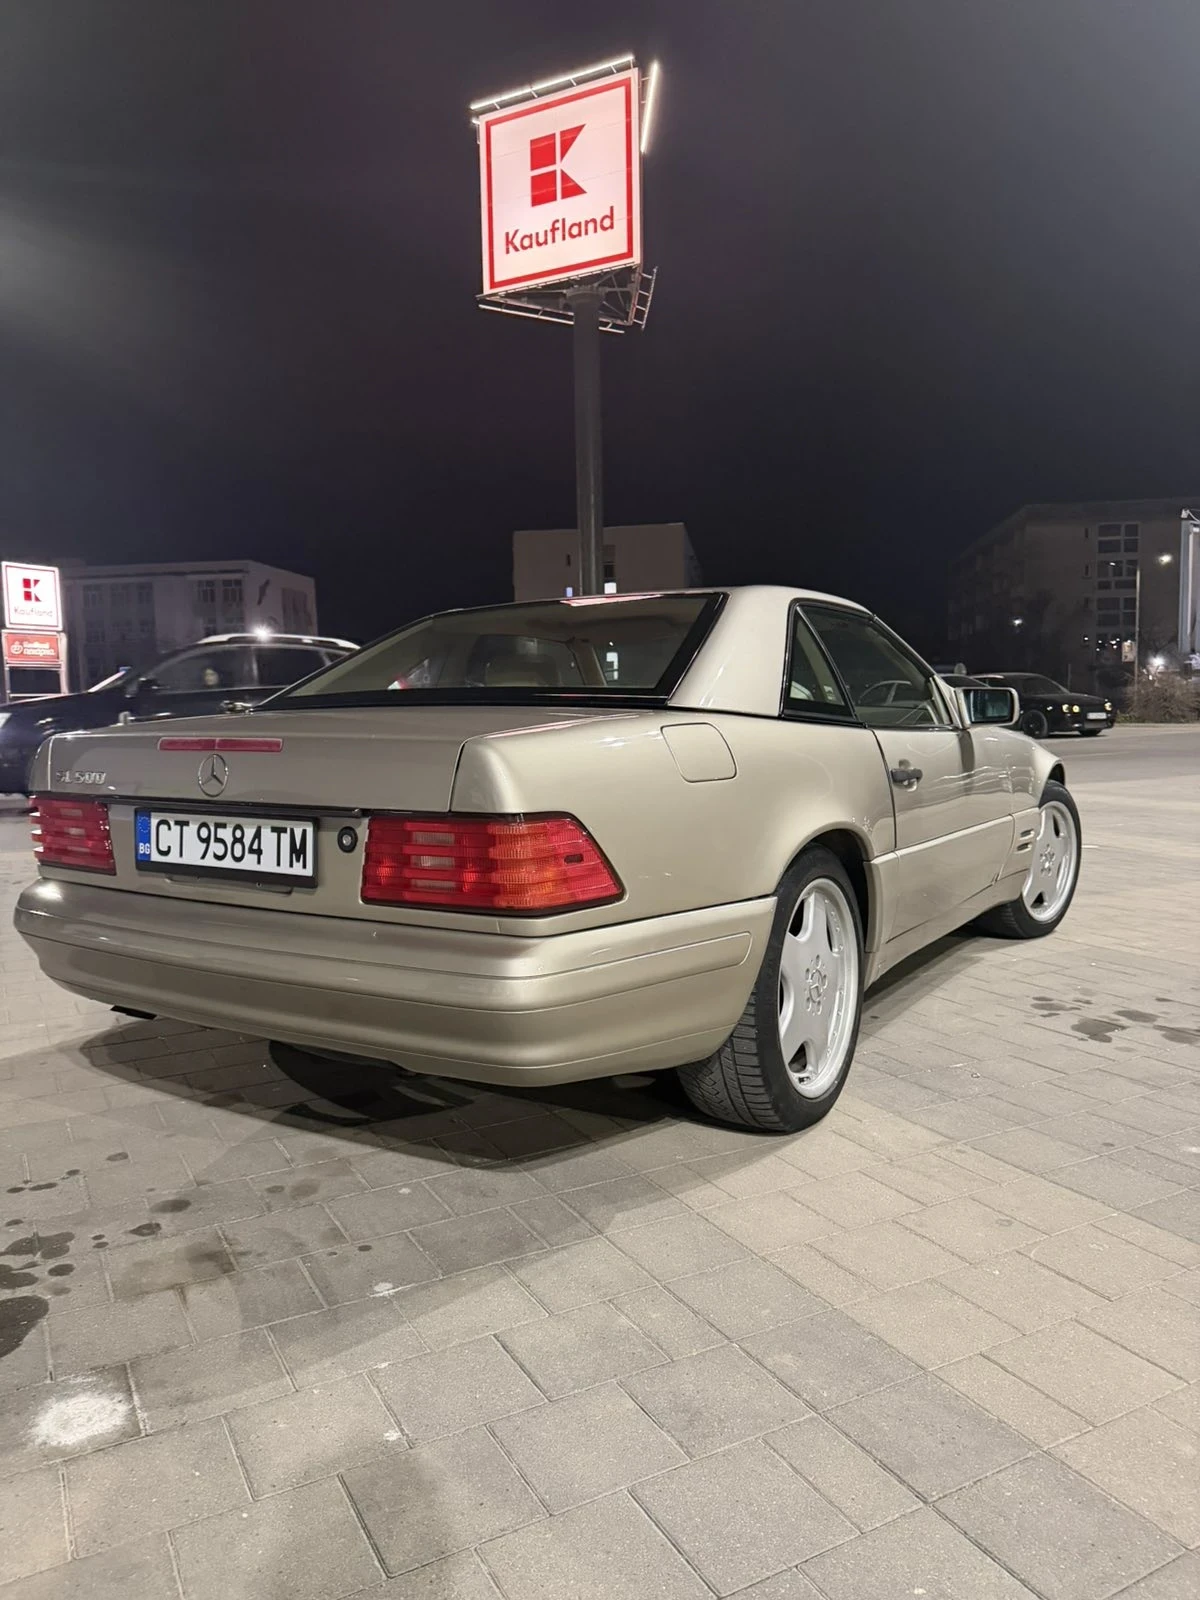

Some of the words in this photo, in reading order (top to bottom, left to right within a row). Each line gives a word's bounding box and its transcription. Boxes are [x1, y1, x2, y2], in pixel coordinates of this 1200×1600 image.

[504, 205, 616, 255] Kaufland
[74, 770, 107, 786] 500
[138, 842, 151, 855] BG
[155, 818, 190, 858] CT
[196, 821, 263, 866] 9584
[270, 825, 308, 870] TM
